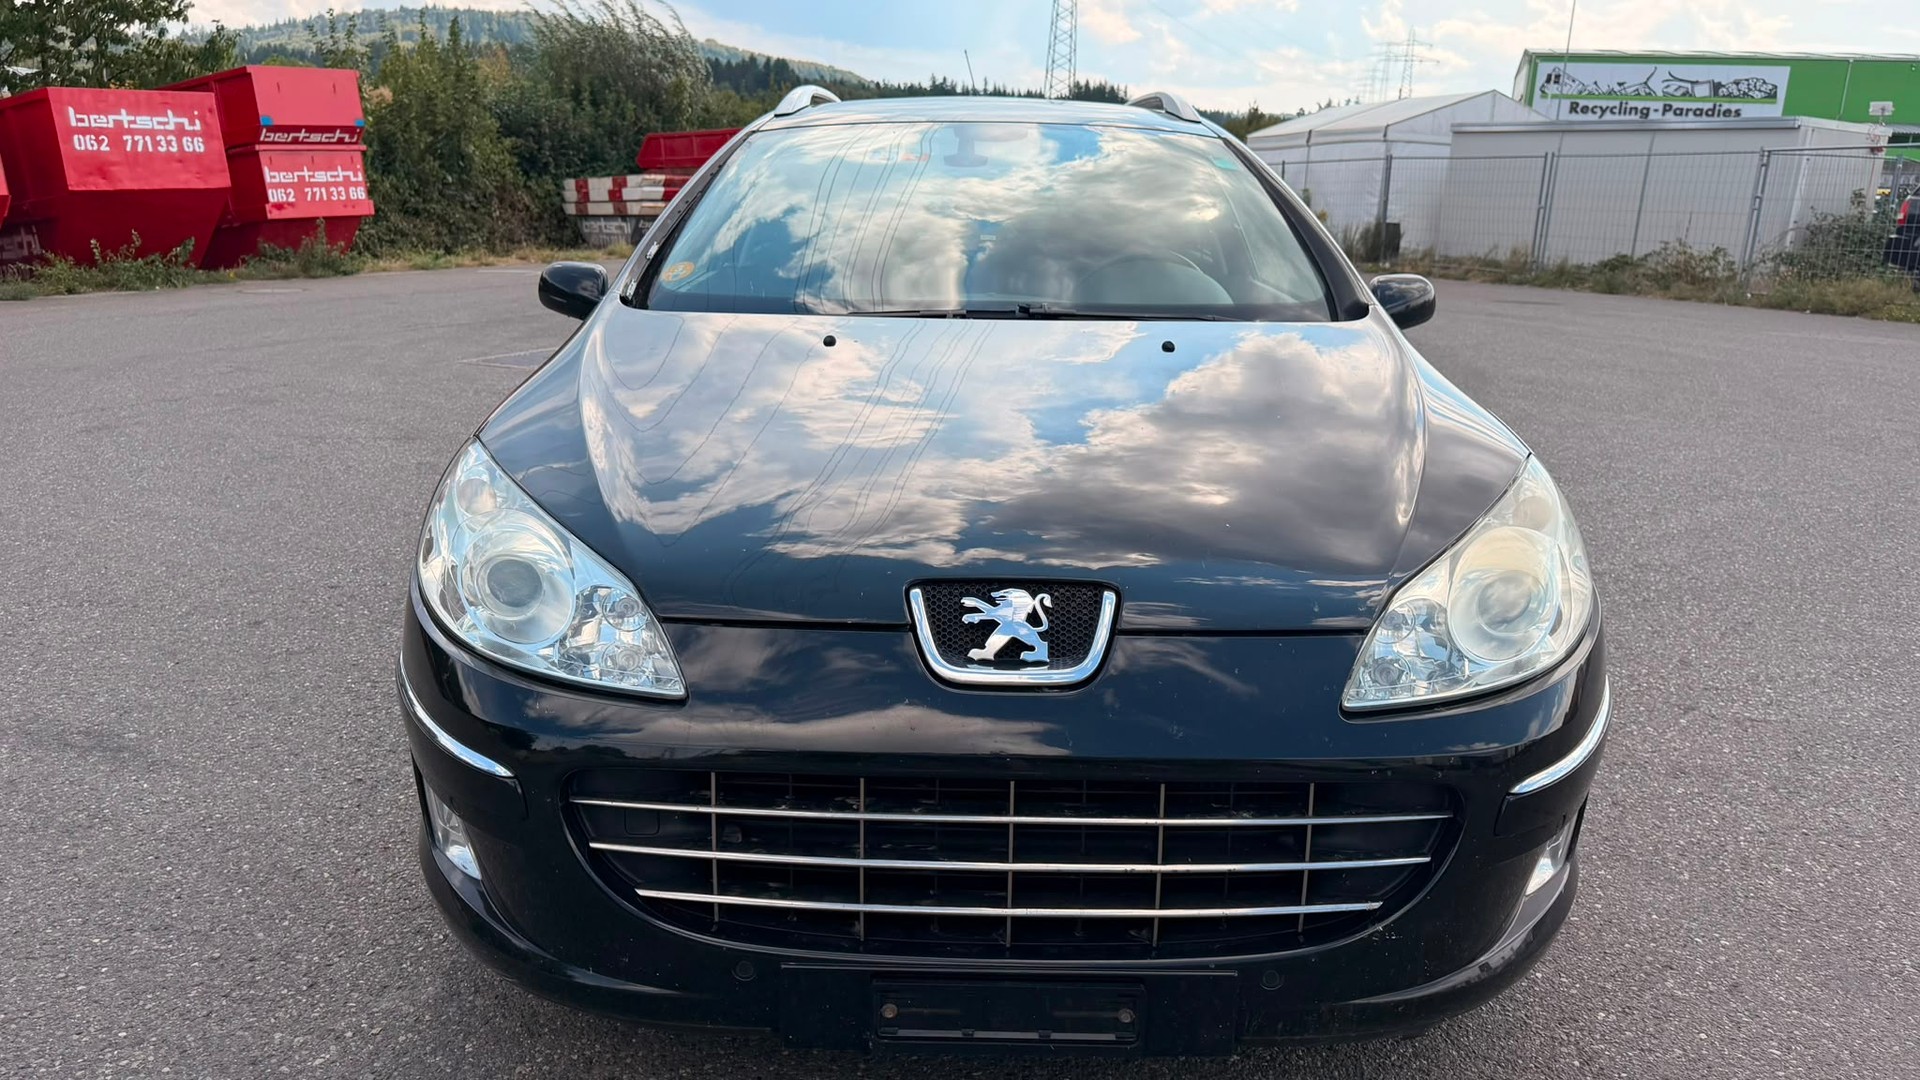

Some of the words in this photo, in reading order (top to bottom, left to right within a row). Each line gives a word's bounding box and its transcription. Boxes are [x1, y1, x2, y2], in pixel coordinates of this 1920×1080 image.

[68, 106, 202, 131] bertschi
[73, 134, 110, 151] 062
[123, 135, 153, 152] 771
[156, 135, 178, 152] 33
[182, 136, 205, 152] 66
[260, 127, 361, 143] bertschi
[264, 165, 363, 183] bertschi
[268, 188, 296, 203] 062
[304, 186, 327, 202] 771
[330, 186, 346, 201] 33
[349, 186, 366, 200] 66
